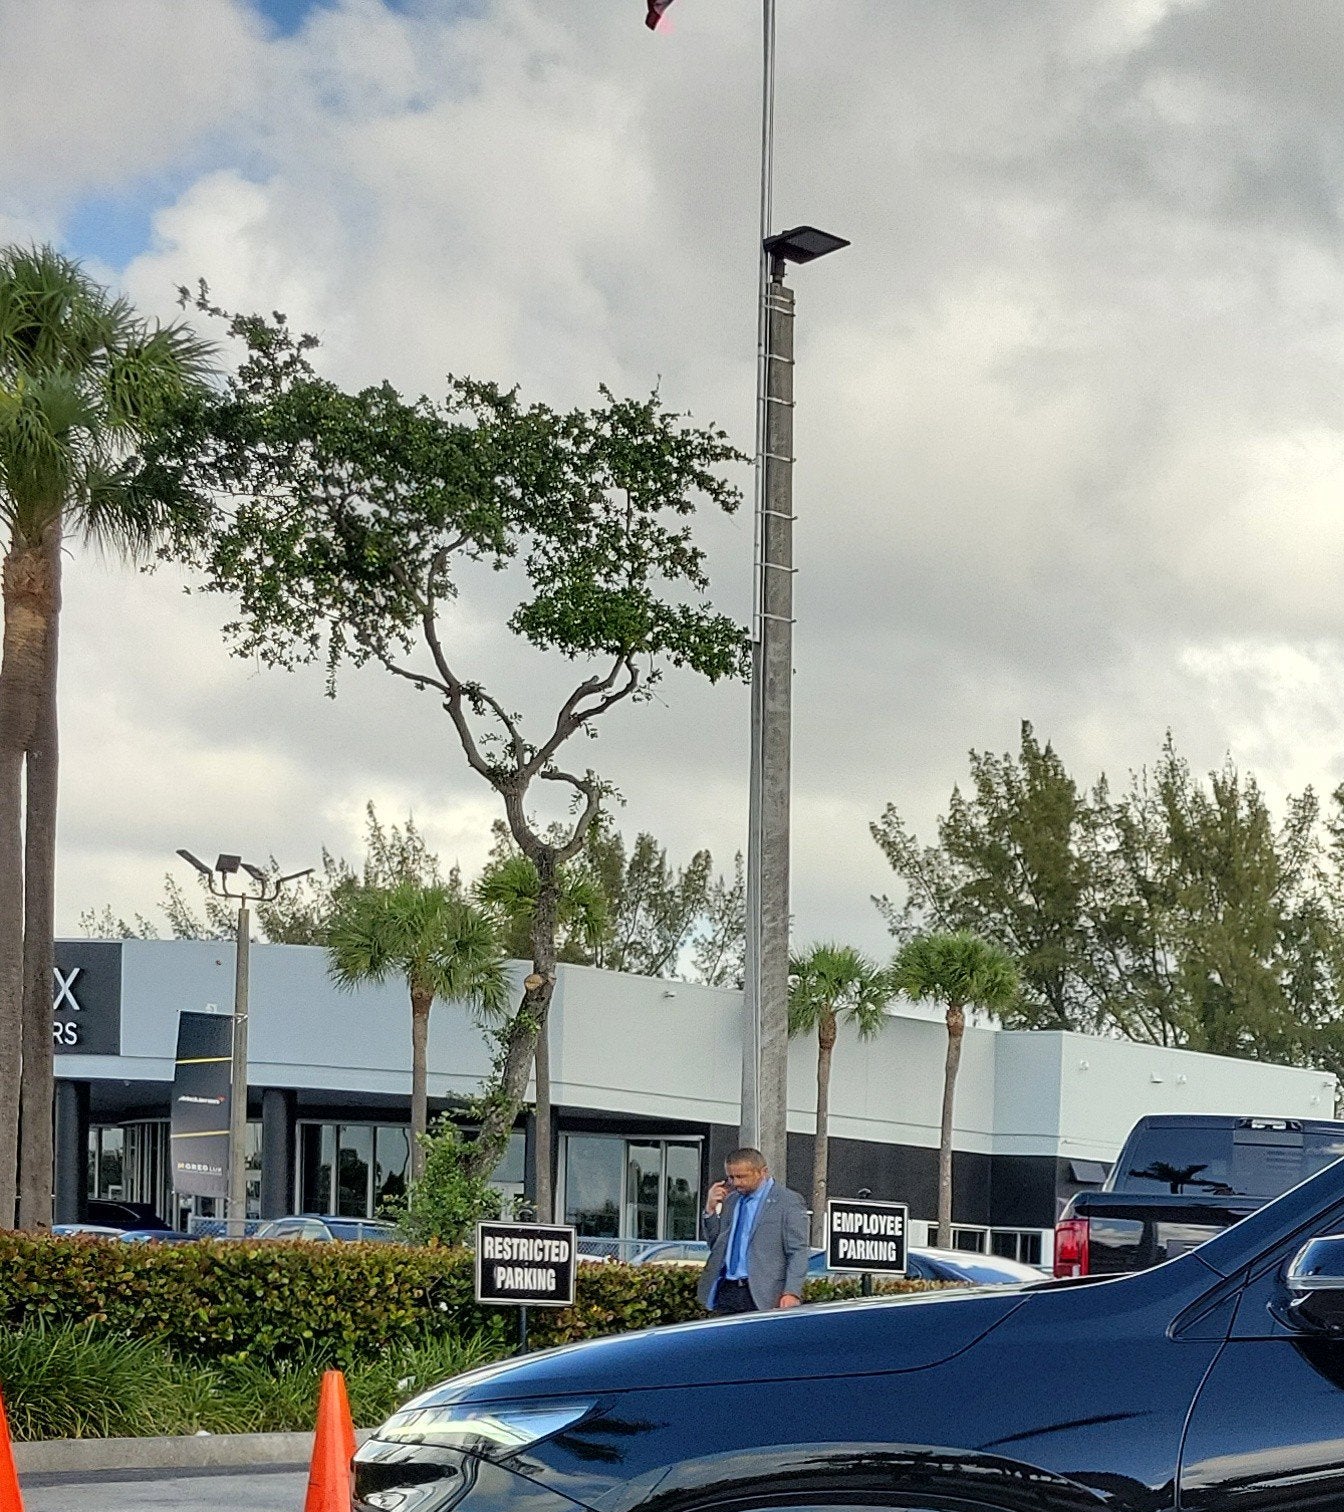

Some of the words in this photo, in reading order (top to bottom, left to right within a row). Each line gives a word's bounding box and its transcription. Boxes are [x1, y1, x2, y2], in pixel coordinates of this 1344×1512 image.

[53, 967, 80, 1011] X
[53, 1022, 78, 1046] RS
[832, 1211, 903, 1236] EMPLOYEE
[483, 1236, 570, 1263] RESTRICTED
[838, 1238, 897, 1262] PARKING
[496, 1266, 557, 1291] PARKING
